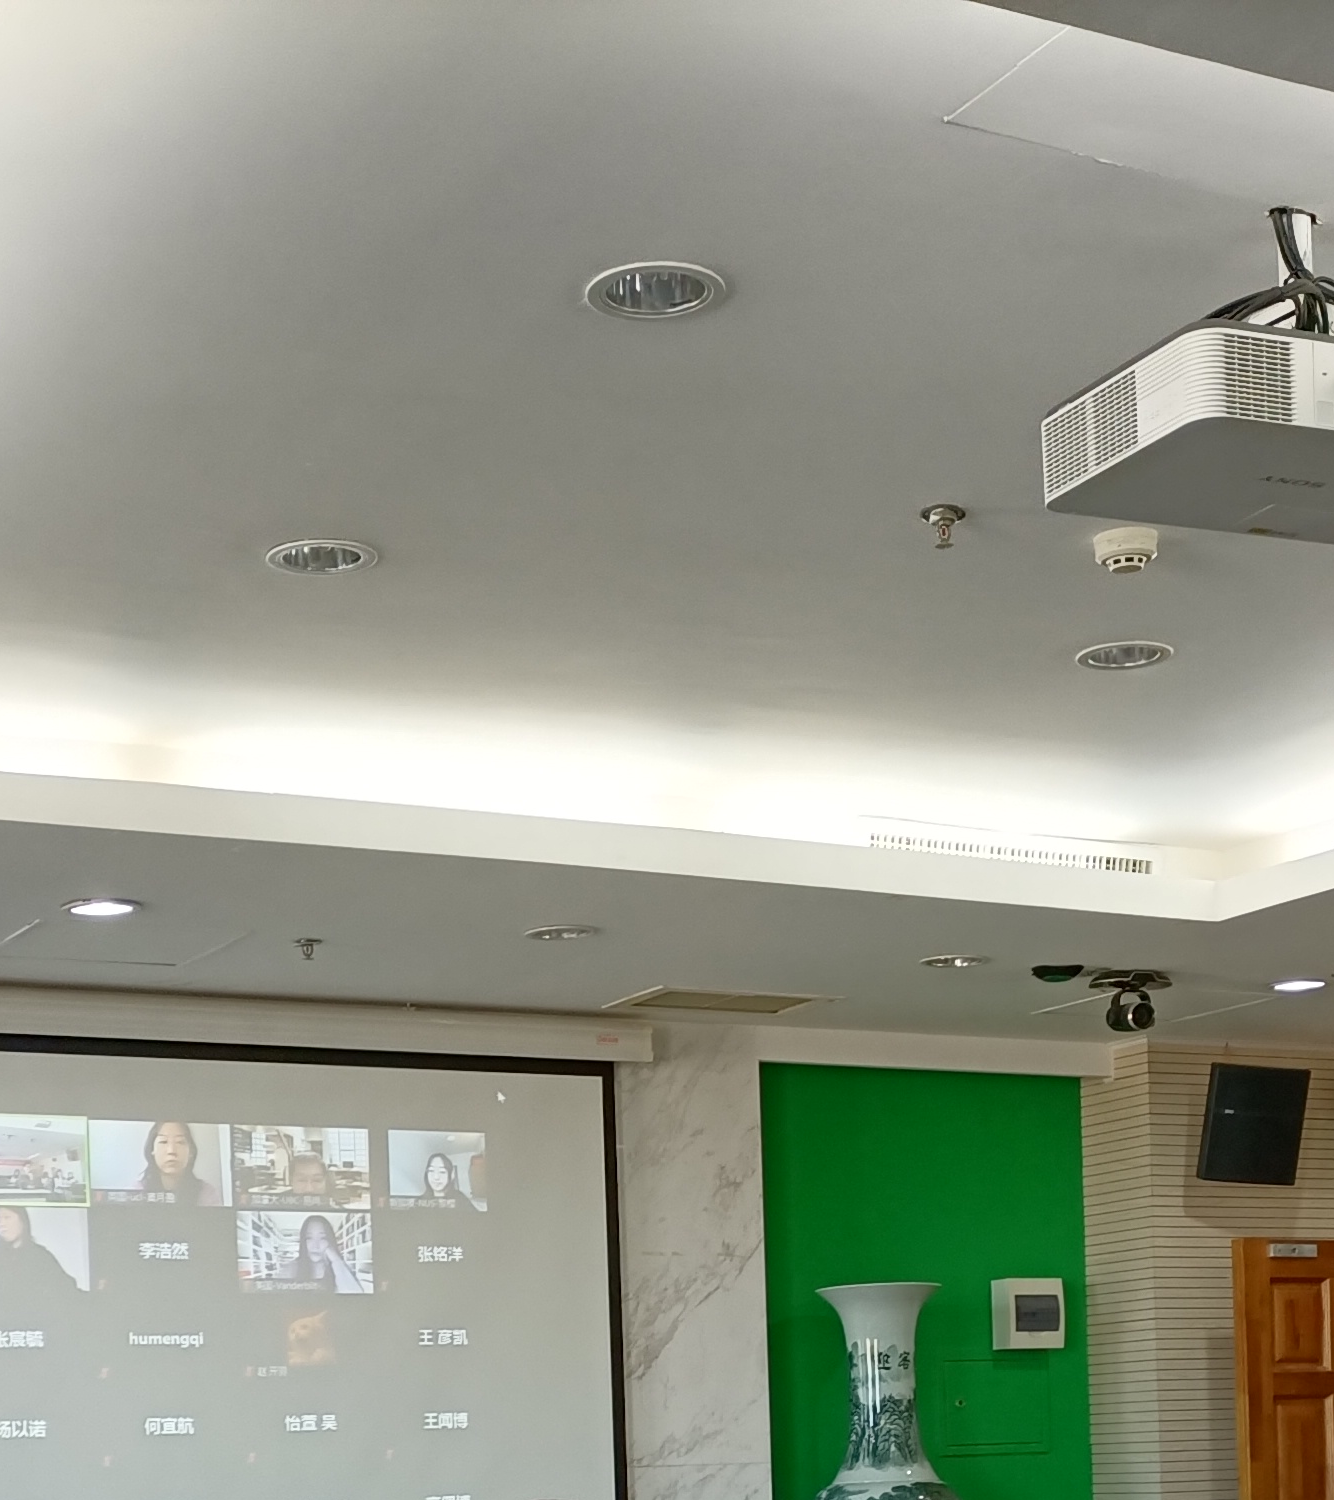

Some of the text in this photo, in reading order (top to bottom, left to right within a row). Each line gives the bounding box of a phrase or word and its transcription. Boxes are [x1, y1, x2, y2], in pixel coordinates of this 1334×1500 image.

[1258, 475, 1325, 490] SONY
[417, 1245, 464, 1263] 张铭洋
[128, 1332, 204, 1348] humengqi
[418, 1329, 434, 1346] 王
[284, 1414, 338, 1432] 怡萱 吴
